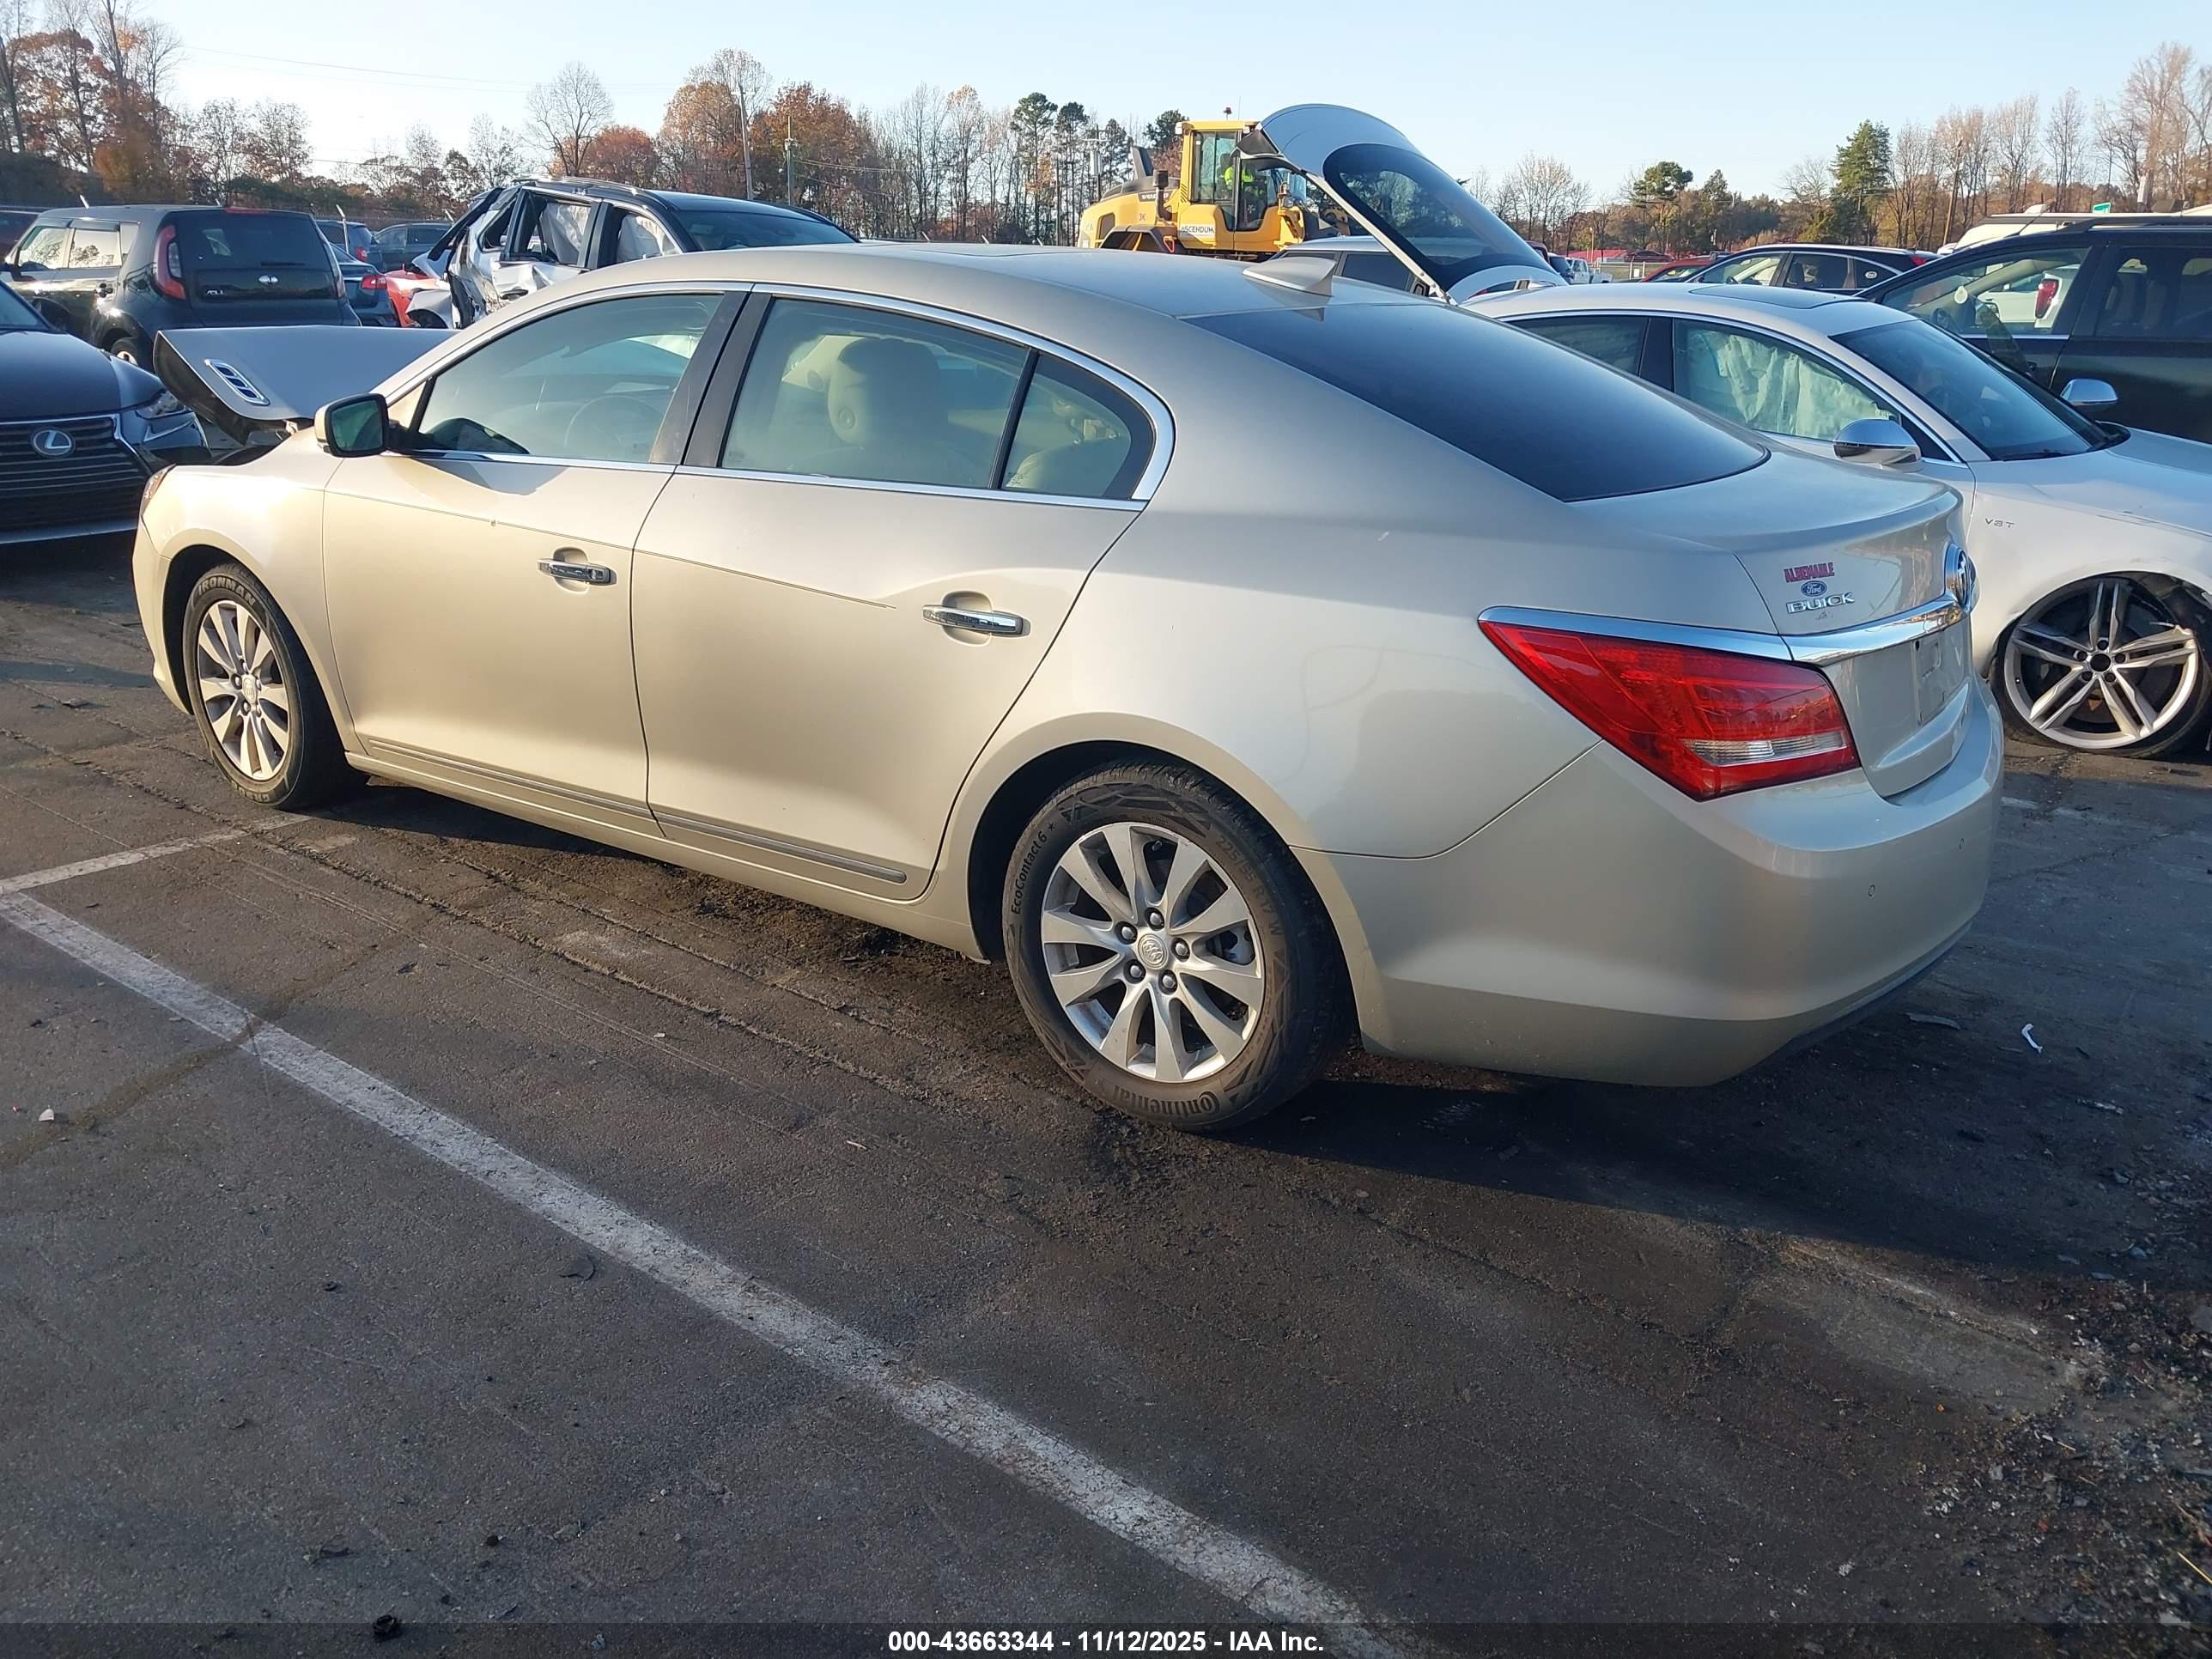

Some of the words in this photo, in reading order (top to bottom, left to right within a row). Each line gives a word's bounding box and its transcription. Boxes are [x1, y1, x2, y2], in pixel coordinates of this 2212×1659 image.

[1180, 225, 1215, 234] ASCENDUM
[198, 576, 256, 606] IRONMAN
[1786, 592, 1855, 614] BUICK
[1011, 841, 1042, 915] EcoContact
[1038, 830, 1048, 843] 6
[1113, 1085, 1219, 1117] Continental
